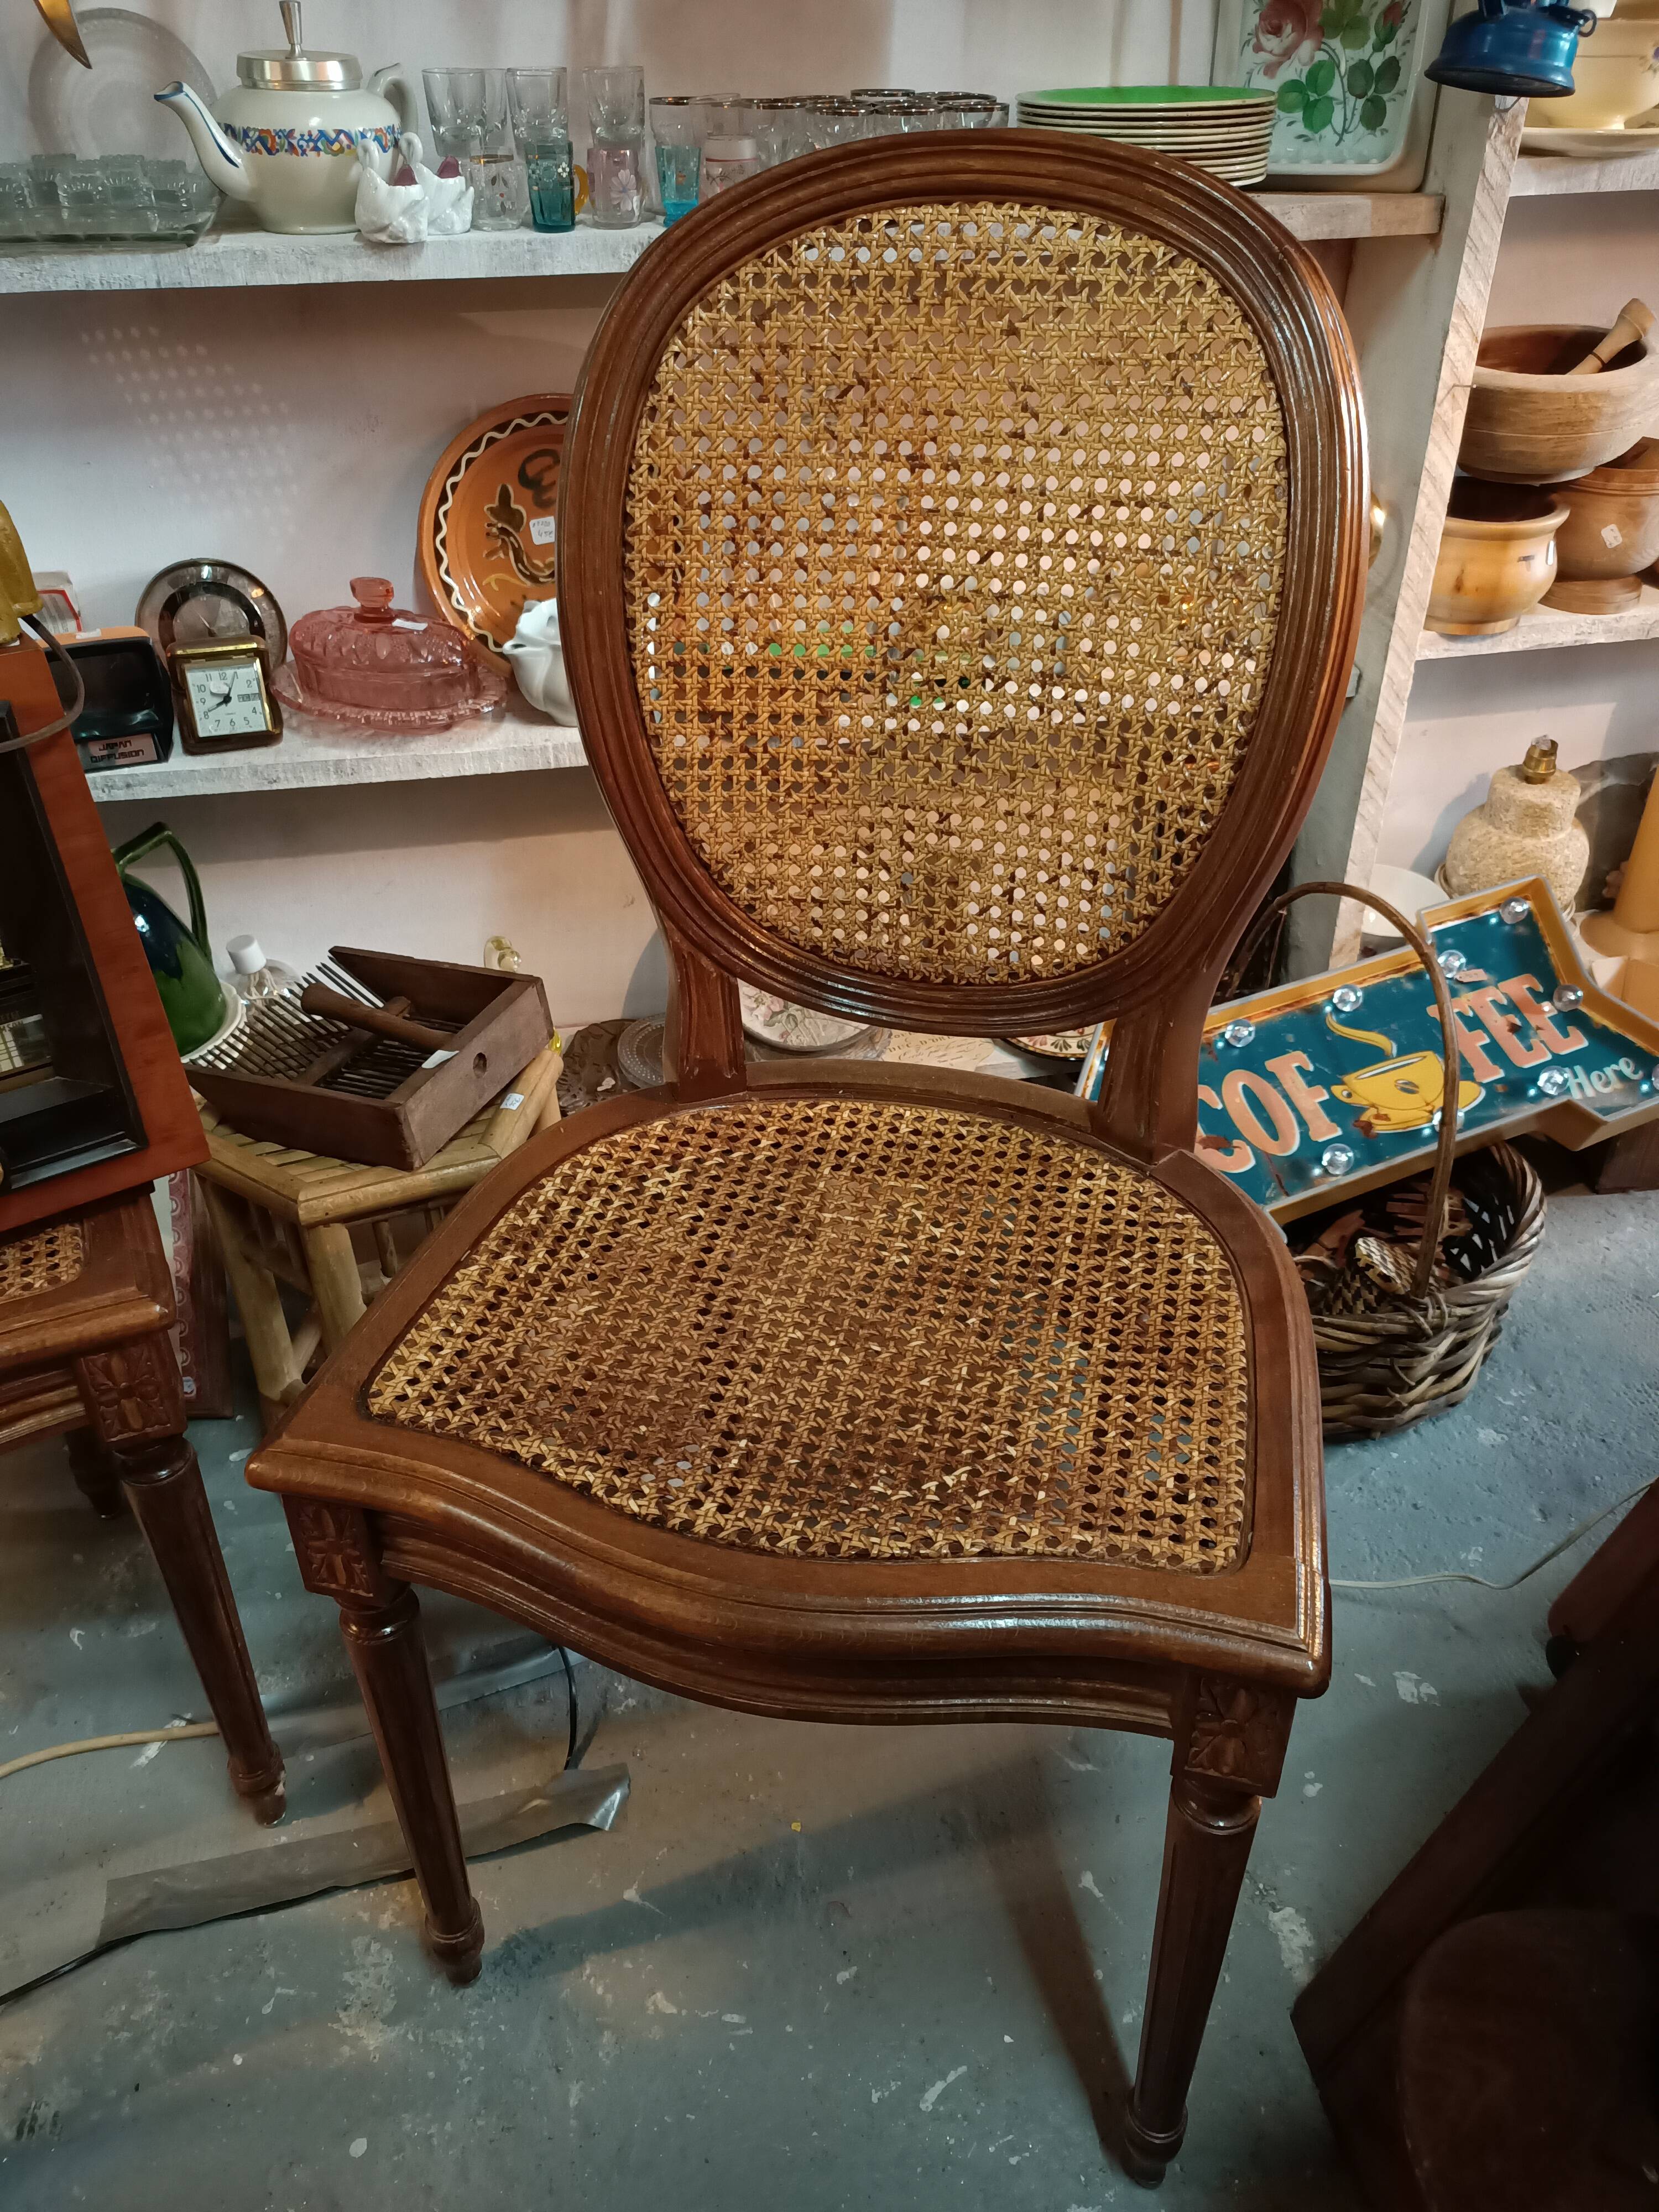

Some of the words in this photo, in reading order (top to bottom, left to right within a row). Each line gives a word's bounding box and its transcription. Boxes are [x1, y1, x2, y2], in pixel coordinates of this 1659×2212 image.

[218, 672, 228, 681] 12
[246, 679, 253, 688] 2
[196, 684, 206, 693] 10
[200, 697, 206, 706] 9
[252, 706, 257, 715] 4
[203, 711, 210, 720] 8
[215, 719, 221, 728] 7
[229, 718, 236, 727] 6
[243, 717, 249, 726] 5
[98, 739, 132, 752] JAPAN
[90, 749, 144, 763] DIFFUSION
[1566, 1057, 1644, 1100] Here
